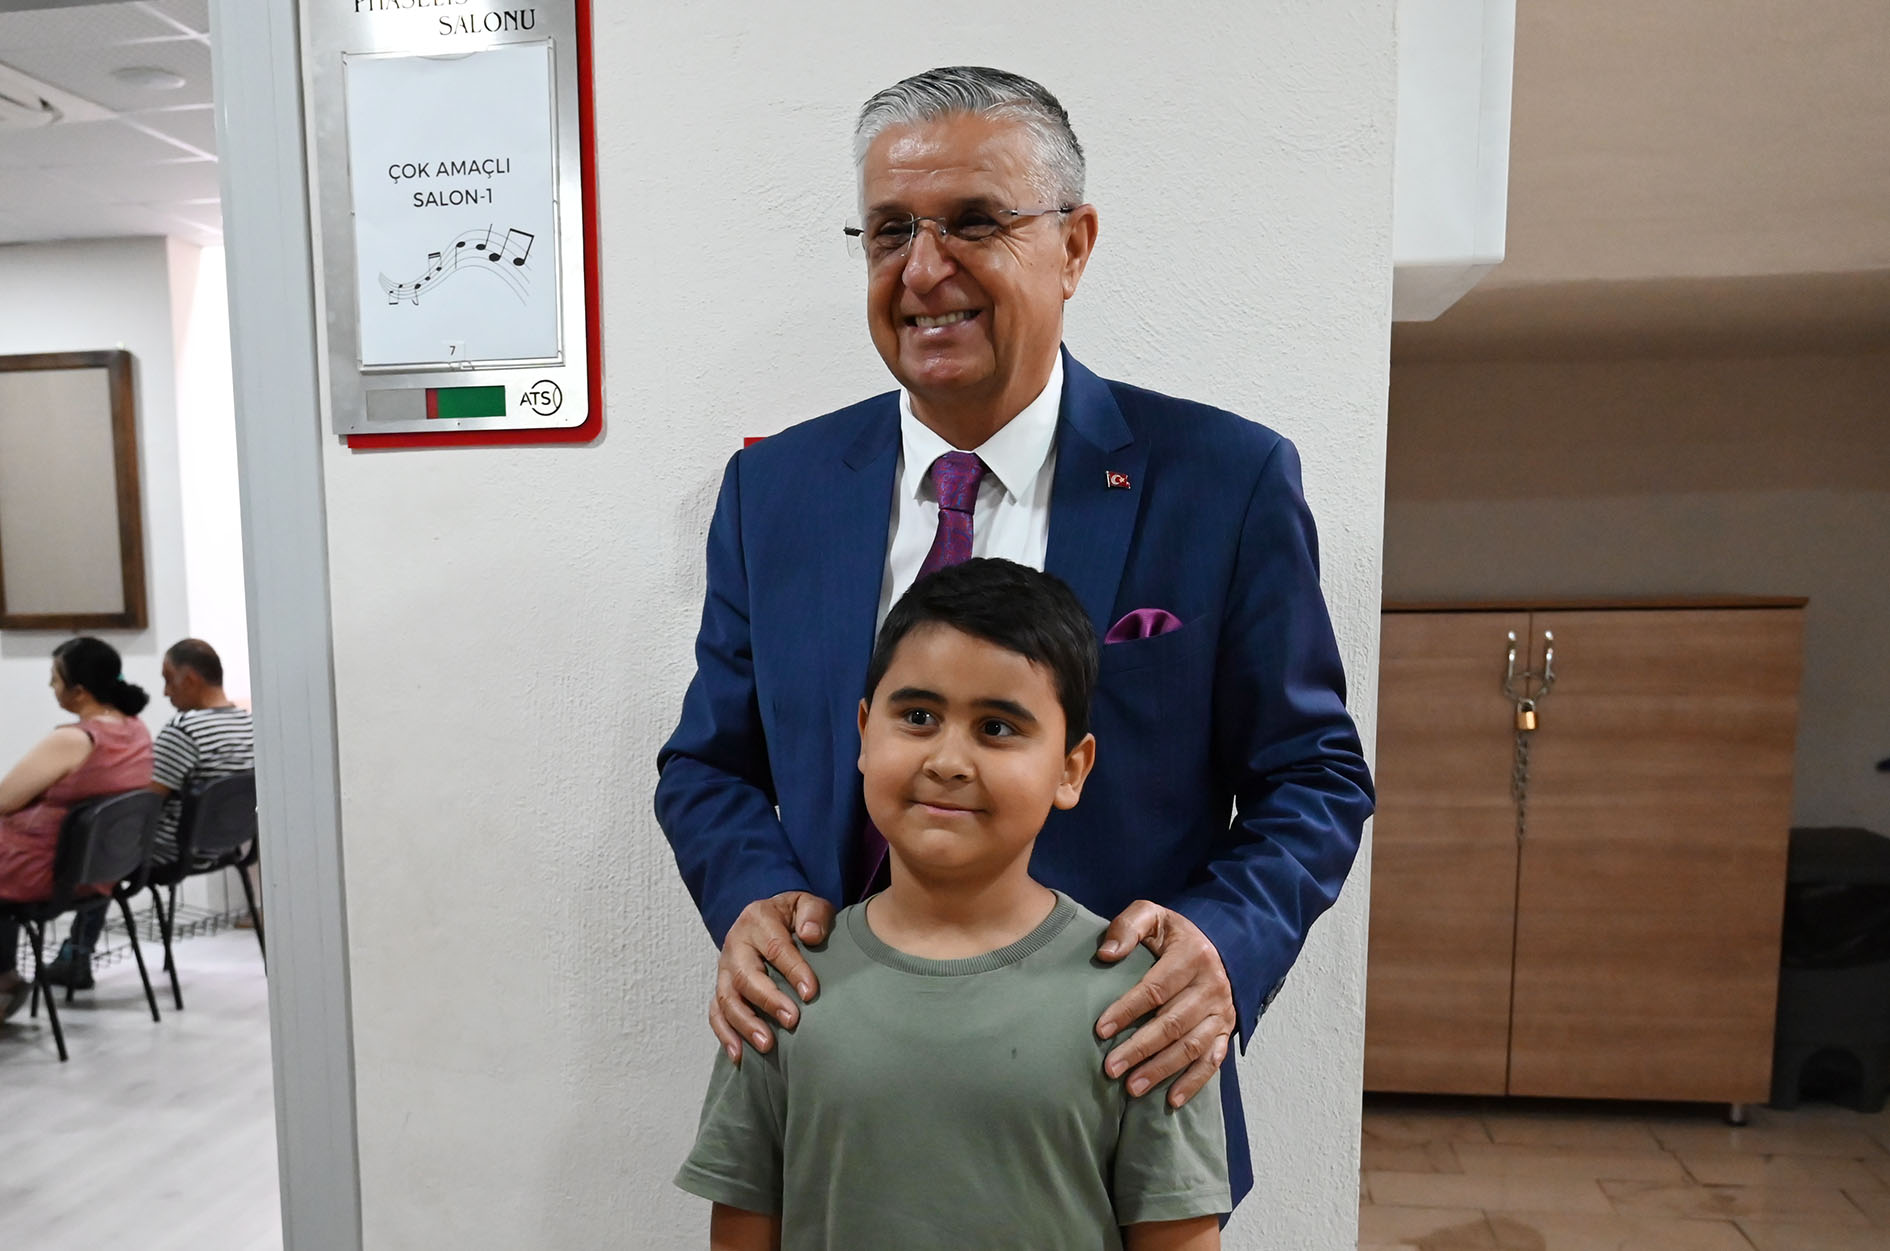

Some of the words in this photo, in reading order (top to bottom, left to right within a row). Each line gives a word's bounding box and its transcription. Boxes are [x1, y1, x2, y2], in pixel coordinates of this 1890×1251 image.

[439, 9, 536, 36] SALONU
[388, 162, 431, 184] ÇOK
[435, 157, 510, 179] AMAÇLI
[413, 188, 493, 208] SALON-1
[449, 345, 456, 356] 7
